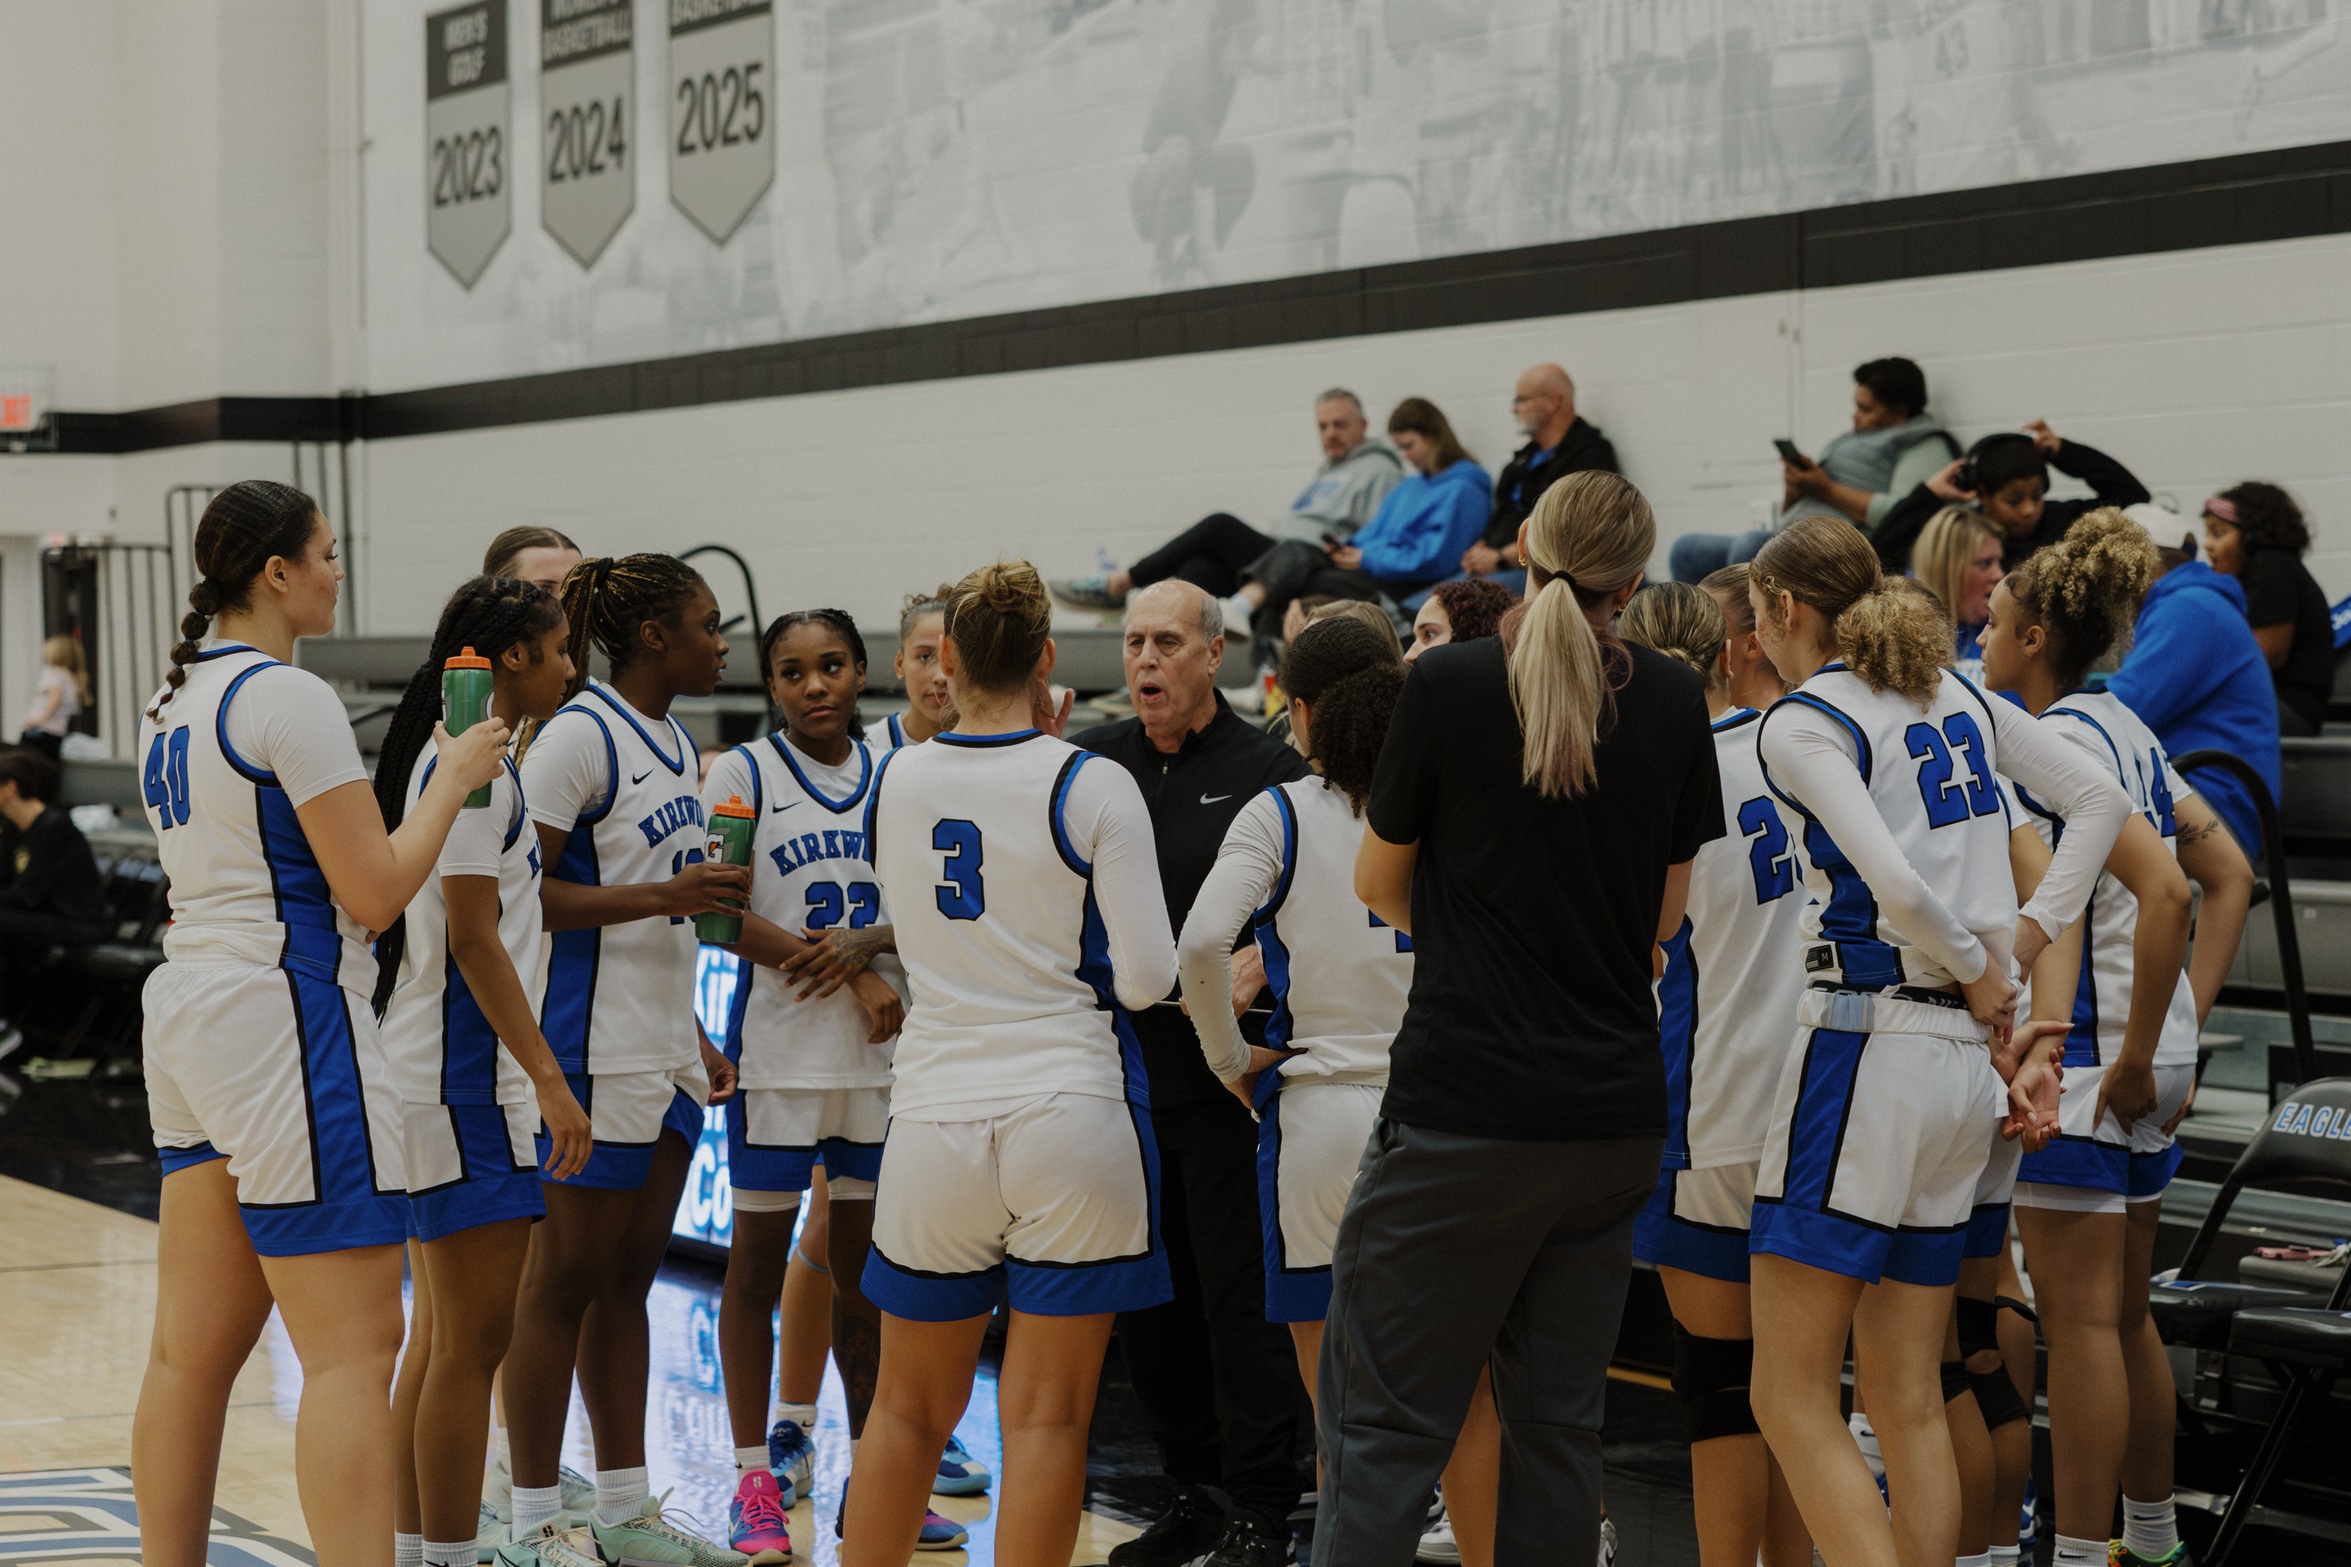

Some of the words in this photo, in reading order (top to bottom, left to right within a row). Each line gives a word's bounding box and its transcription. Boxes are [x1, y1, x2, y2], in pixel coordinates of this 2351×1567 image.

[548, 96, 626, 183] 2024
[677, 62, 764, 157] 2025
[433, 125, 502, 208] 2023
[143, 725, 191, 831] 40
[1904, 710, 2000, 830] 23
[638, 795, 705, 849] KIRKWO
[932, 818, 985, 921] 3
[1737, 794, 1805, 906] 2
